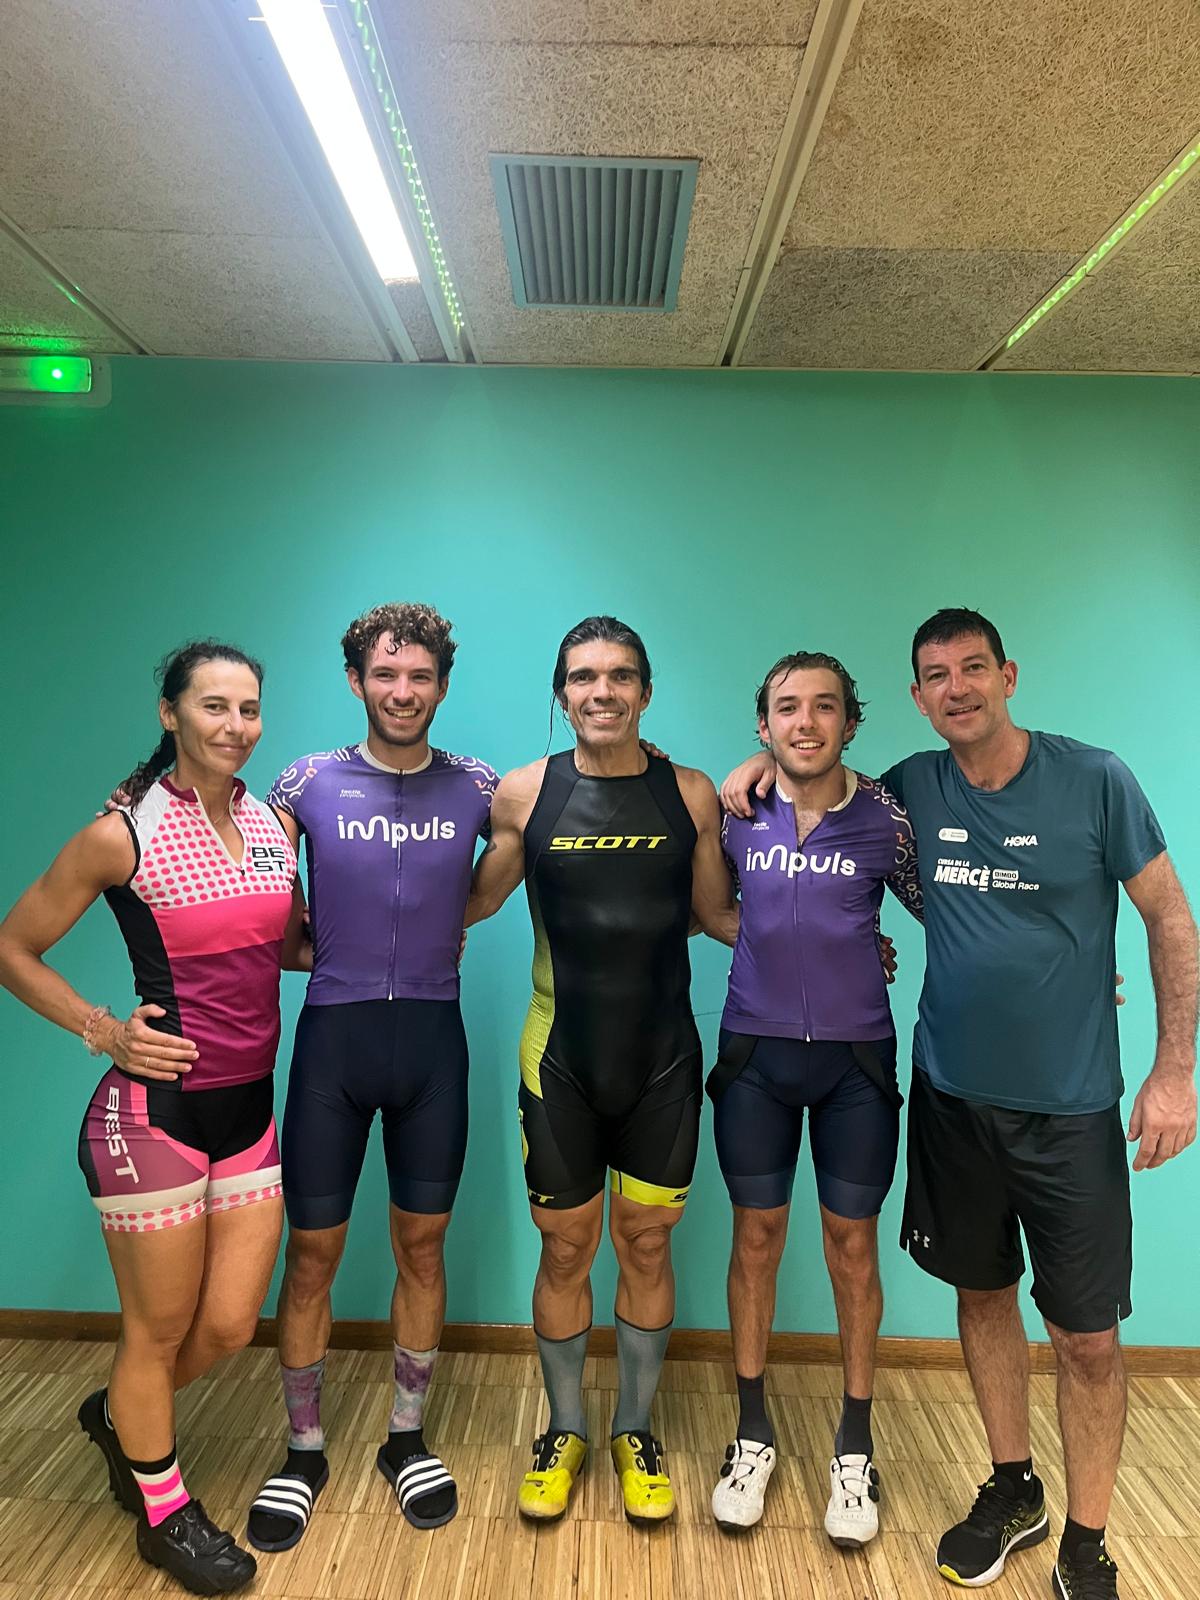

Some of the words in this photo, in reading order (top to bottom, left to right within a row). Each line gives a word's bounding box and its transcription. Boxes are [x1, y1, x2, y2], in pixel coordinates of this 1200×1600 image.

[549, 836, 668, 850] SCOTT
[1003, 834, 1039, 847] HOKA
[933, 864, 991, 888] MERCÈ
[994, 871, 1018, 879] BIMBO
[992, 880, 1017, 890] Global
[1018, 881, 1040, 891] Race
[104, 1086, 140, 1184] BEST
